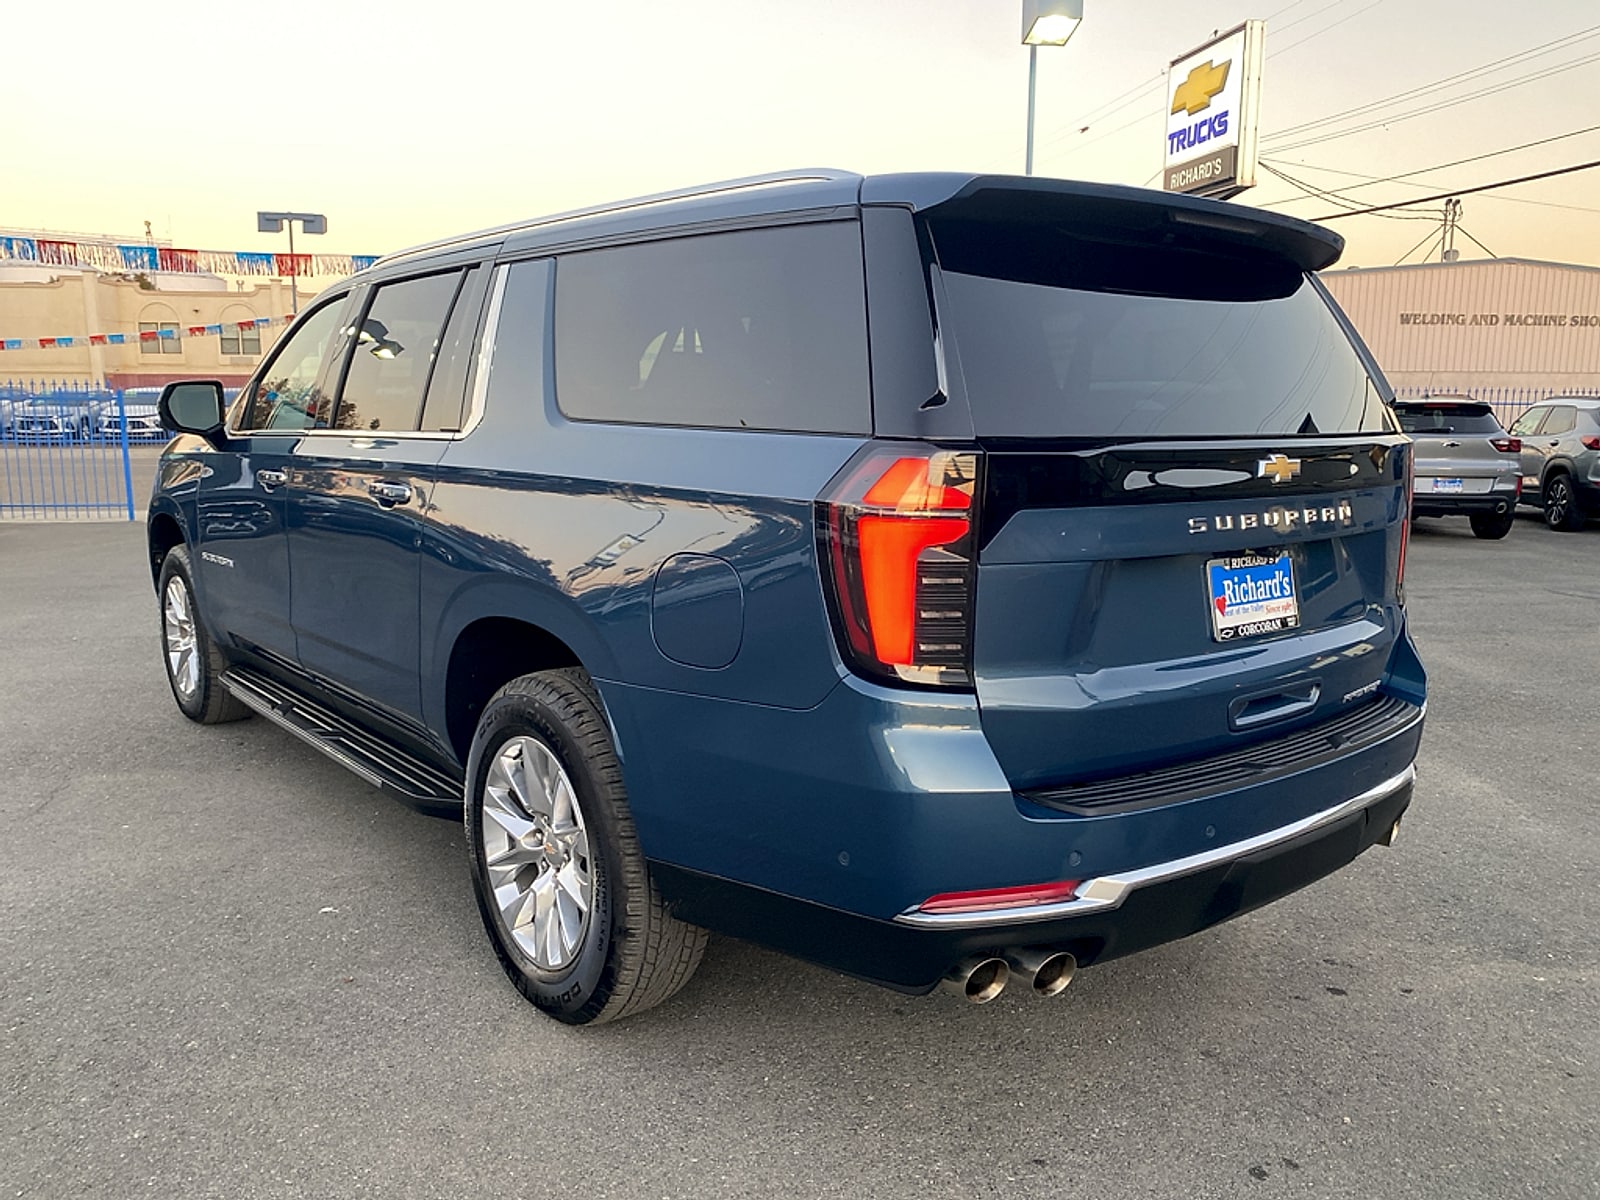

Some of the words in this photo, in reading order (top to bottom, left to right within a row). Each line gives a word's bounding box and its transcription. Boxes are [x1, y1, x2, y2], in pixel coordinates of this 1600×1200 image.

[1168, 110, 1229, 155] TRUCKS
[1170, 158, 1222, 190] RICHARD'S
[1399, 312, 1466, 326] WELDING
[1468, 313, 1500, 327] AND
[1503, 314, 1567, 327] MACHINE
[1570, 314, 1600, 328] SHO
[1188, 505, 1352, 534] SUBURBAN
[1223, 571, 1290, 605] Richard's
[1238, 619, 1281, 636] CORCORAN
